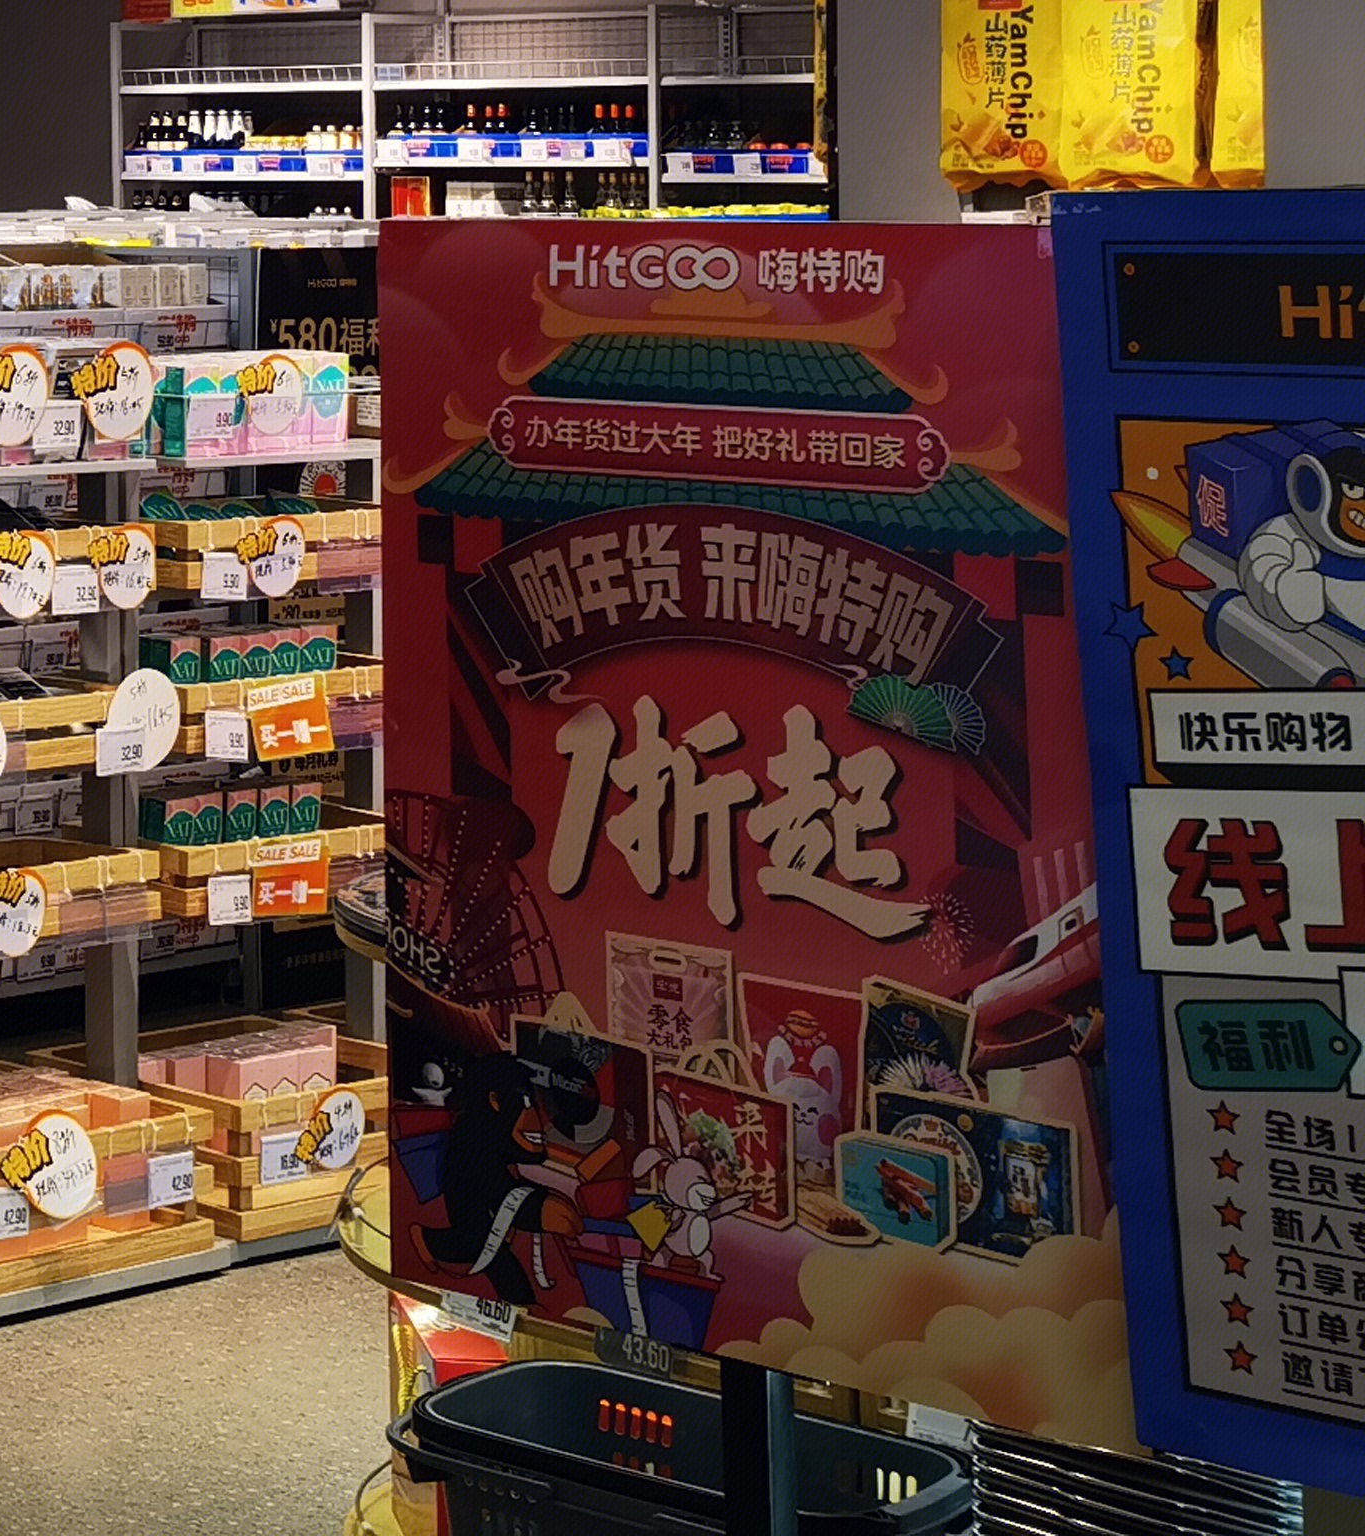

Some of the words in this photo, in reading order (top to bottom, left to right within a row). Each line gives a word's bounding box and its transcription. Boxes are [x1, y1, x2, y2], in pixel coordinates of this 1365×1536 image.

[549, 245, 740, 290] HitGOO
[757, 249, 885, 295] 嗨特购
[53, 420, 75, 436] 32.90
[215, 412, 233, 428] 9.90
[524, 415, 704, 457] 办年货过大年
[712, 424, 906, 470] 把好礼带回家
[512, 524, 687, 650] 购年货
[700, 524, 955, 684] 来嗨特购
[211, 658, 238, 679] NAT
[300, 647, 335, 668] NAT
[172, 660, 198, 680] NAT
[250, 688, 280, 706] SALE
[281, 683, 313, 700] SALE
[1179, 711, 1353, 753] 快乐购物
[121, 743, 143, 761] 32.90
[548, 694, 929, 939] 1折起
[255, 846, 286, 862] SALE
[288, 843, 320, 859] SALE
[1197, 1020, 1316, 1073] 福利
[171, 1173, 193, 1191] 42.90
[3, 1206, 27, 1225] 42.90
[1278, 1301, 1365, 1350] 订单
[622, 1333, 670, 1372] 43.60
[1281, 1350, 1365, 1398] 邀请
